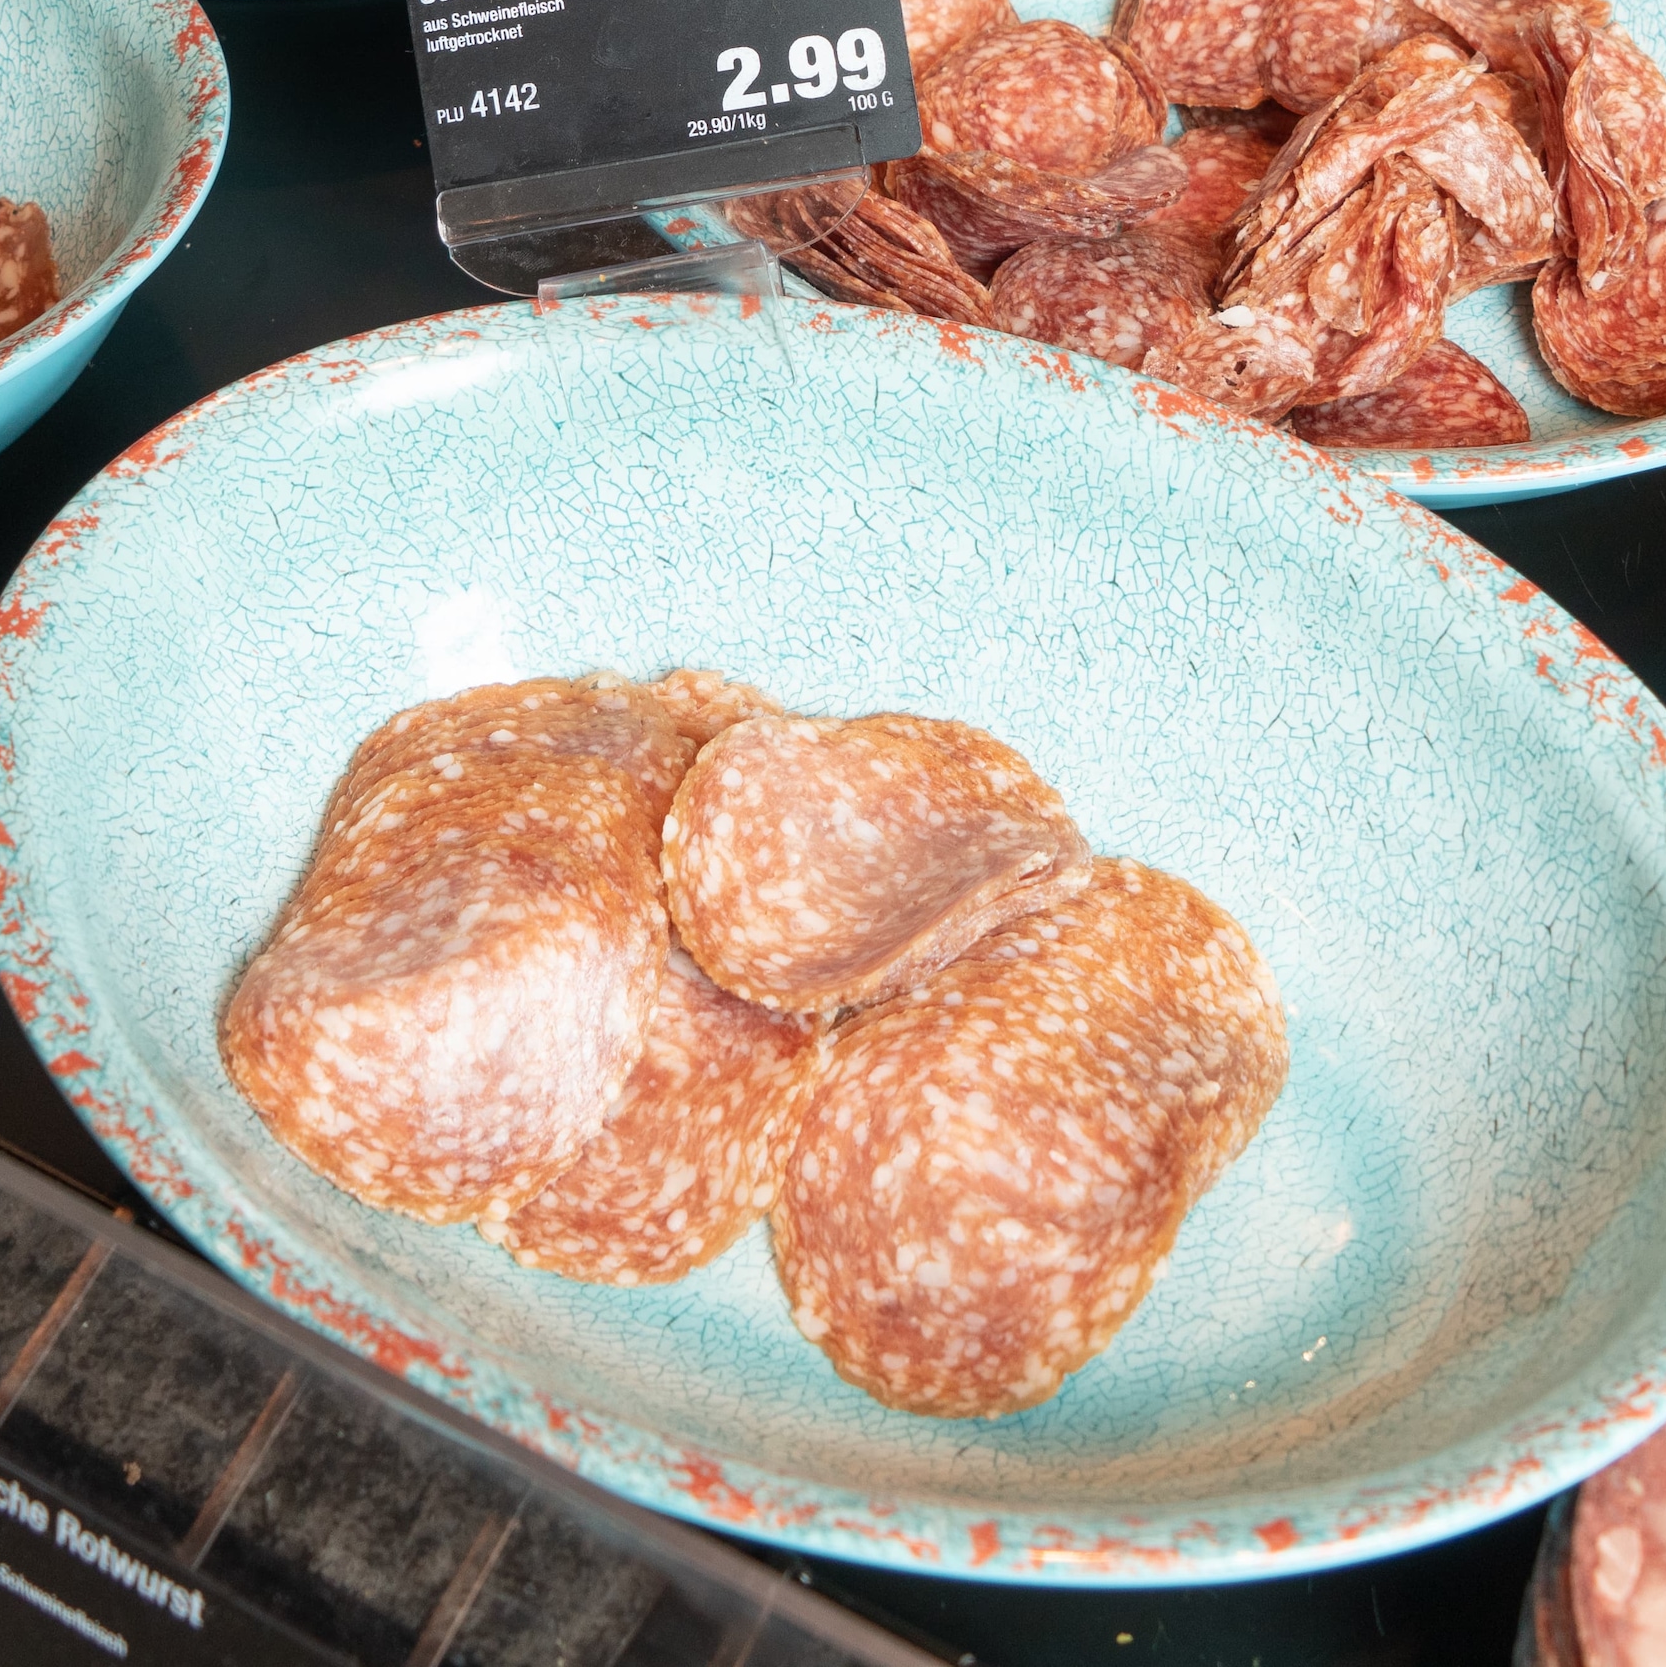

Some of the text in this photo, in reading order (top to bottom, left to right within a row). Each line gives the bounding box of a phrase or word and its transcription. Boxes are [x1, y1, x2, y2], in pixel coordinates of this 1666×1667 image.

[422, 17, 448, 33] aus
[425, 23, 523, 52] luftgetrocknet
[716, 26, 890, 112] 2.99
[436, 82, 540, 124] PLU 4142
[847, 90, 894, 111] 100 G
[686, 111, 766, 137] 29.90/1kg
[55, 1509, 204, 1627] Rotwurst
